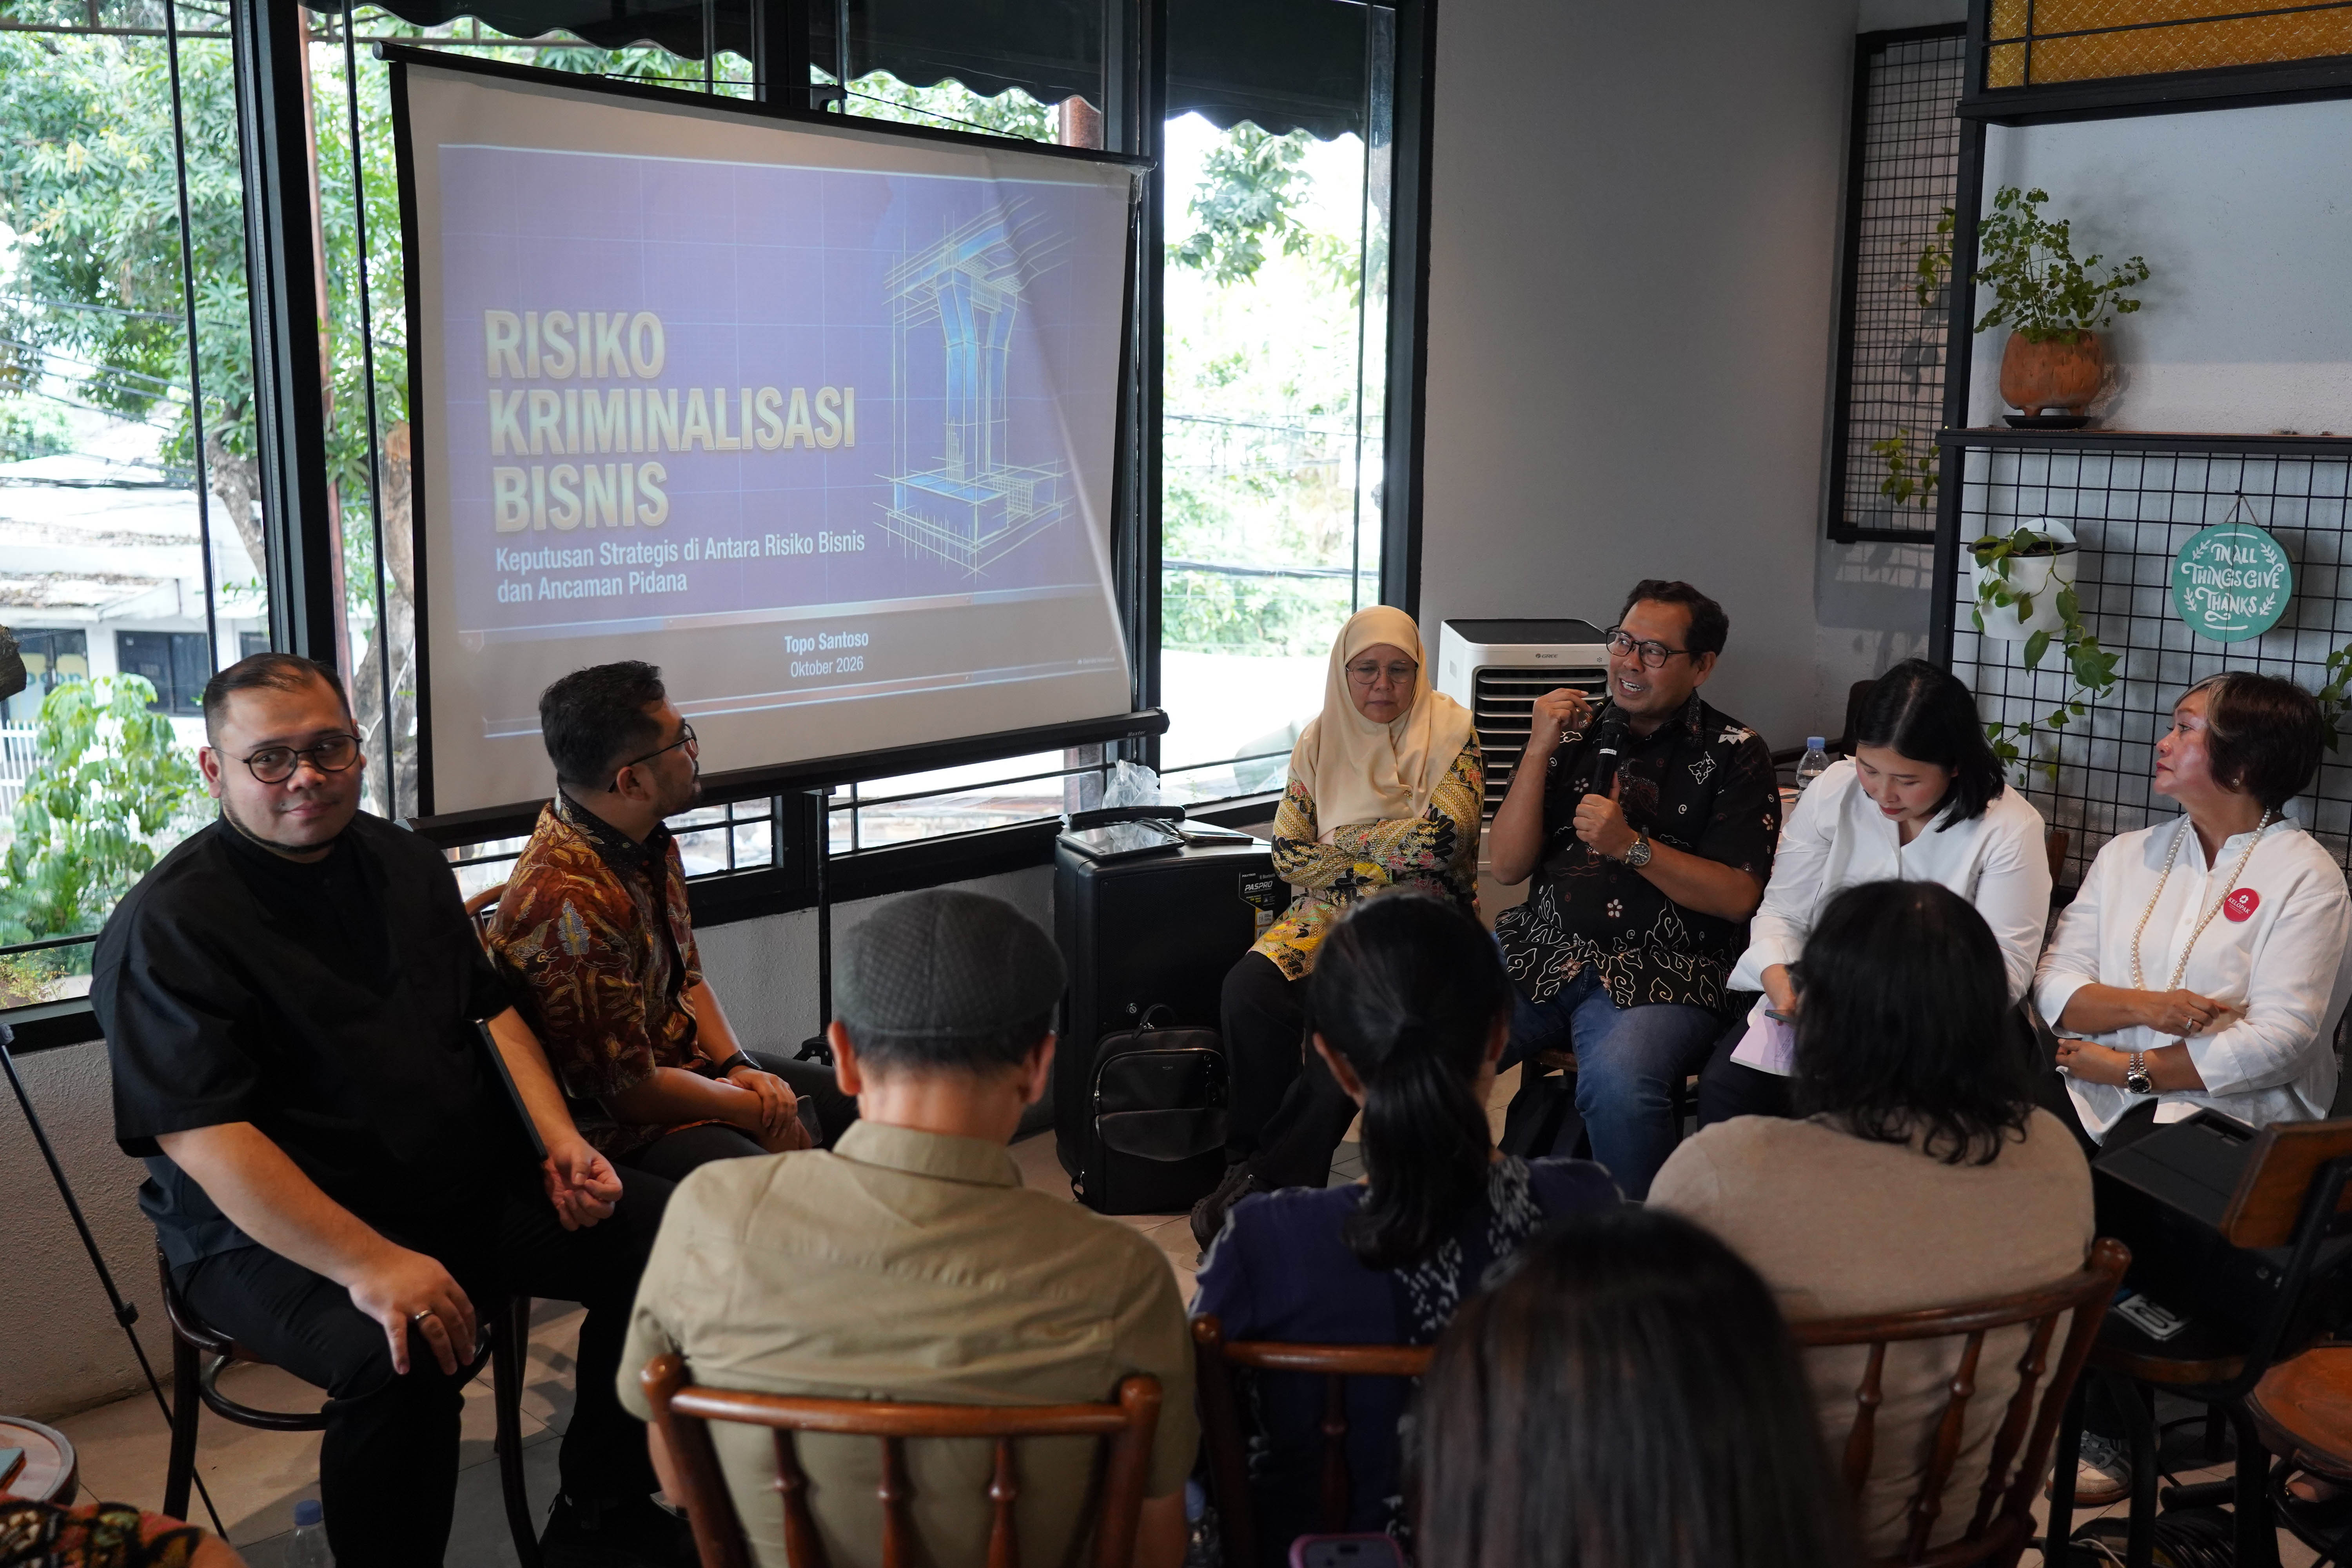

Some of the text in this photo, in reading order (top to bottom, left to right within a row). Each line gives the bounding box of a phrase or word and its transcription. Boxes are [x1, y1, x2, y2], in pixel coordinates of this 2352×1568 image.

[484, 309, 665, 379] RISIKO
[489, 386, 855, 455] KRIMINALISASI
[493, 461, 668, 532] BISNIS
[496, 530, 865, 575] Keputusan Strategis di Antara Risiko Bisnis
[2211, 543, 2258, 565] IN ALL
[497, 571, 687, 603] dan Ancaman Pidana
[2181, 562, 2285, 589] THINGS GIVE
[2195, 586, 2258, 617] THANKS
[785, 631, 869, 655] Topo Santoso
[791, 655, 864, 677] Oktober 2026
[1244, 880, 1273, 891] PASPRO
[2227, 897, 2250, 914] KELOPAK
